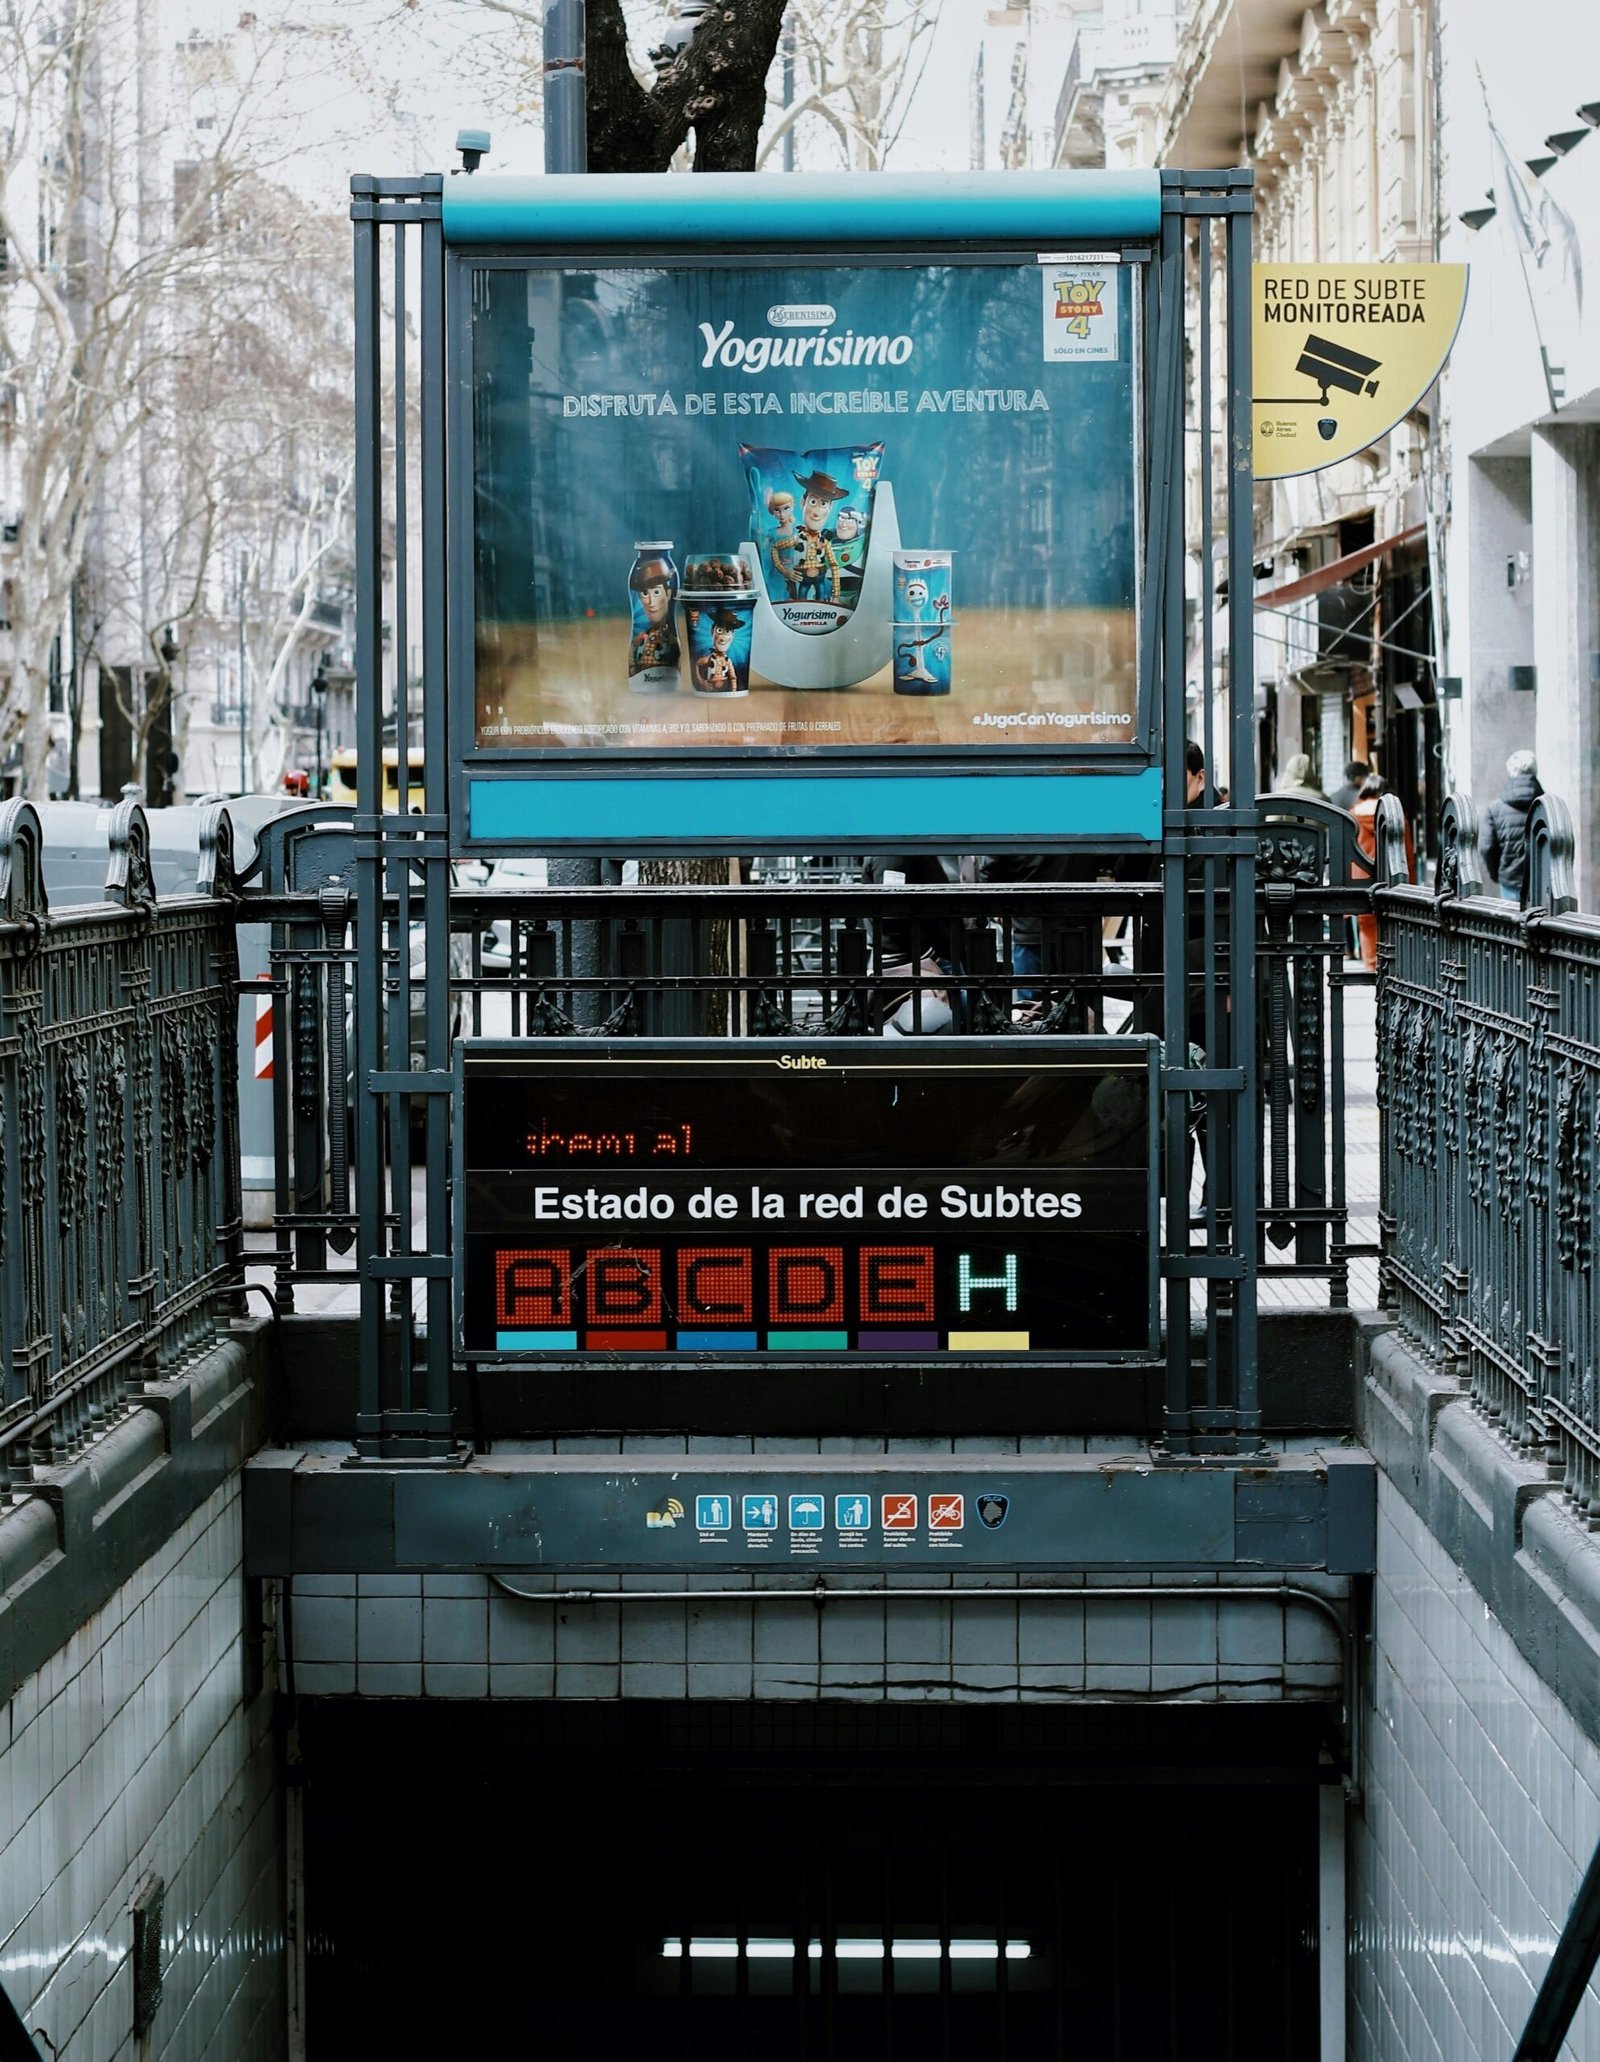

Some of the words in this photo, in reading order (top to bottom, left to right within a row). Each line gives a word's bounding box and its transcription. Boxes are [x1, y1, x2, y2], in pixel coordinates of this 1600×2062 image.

[1054, 280, 1106, 303] TOY
[1265, 279, 1309, 300] RED
[1318, 279, 1346, 300] DE
[1354, 279, 1426, 300] SUBTE
[1060, 304, 1098, 314] STORY
[1264, 303, 1426, 323] MONITOREADA
[1066, 314, 1091, 339] 4
[698, 320, 914, 374] Yogurísimo
[563, 390, 678, 417] DISFRUTÁ
[685, 393, 716, 415] DE
[723, 392, 783, 415] ESTA
[790, 388, 908, 414] INCREÍBLE
[915, 389, 1050, 412] AVENTURA
[781, 1055, 827, 1069] Subte
[534, 1187, 675, 1220] Estado
[688, 1187, 738, 1219] de
[751, 1186, 785, 1219] la
[800, 1186, 864, 1219] red
[877, 1186, 928, 1219] de
[940, 1185, 1082, 1219] Subtes
[503, 1256, 564, 1318] A
[595, 1256, 652, 1316] B
[685, 1255, 745, 1315] C
[776, 1255, 837, 1314] D
[868, 1255, 926, 1314] E
[959, 1254, 1017, 1312] H
